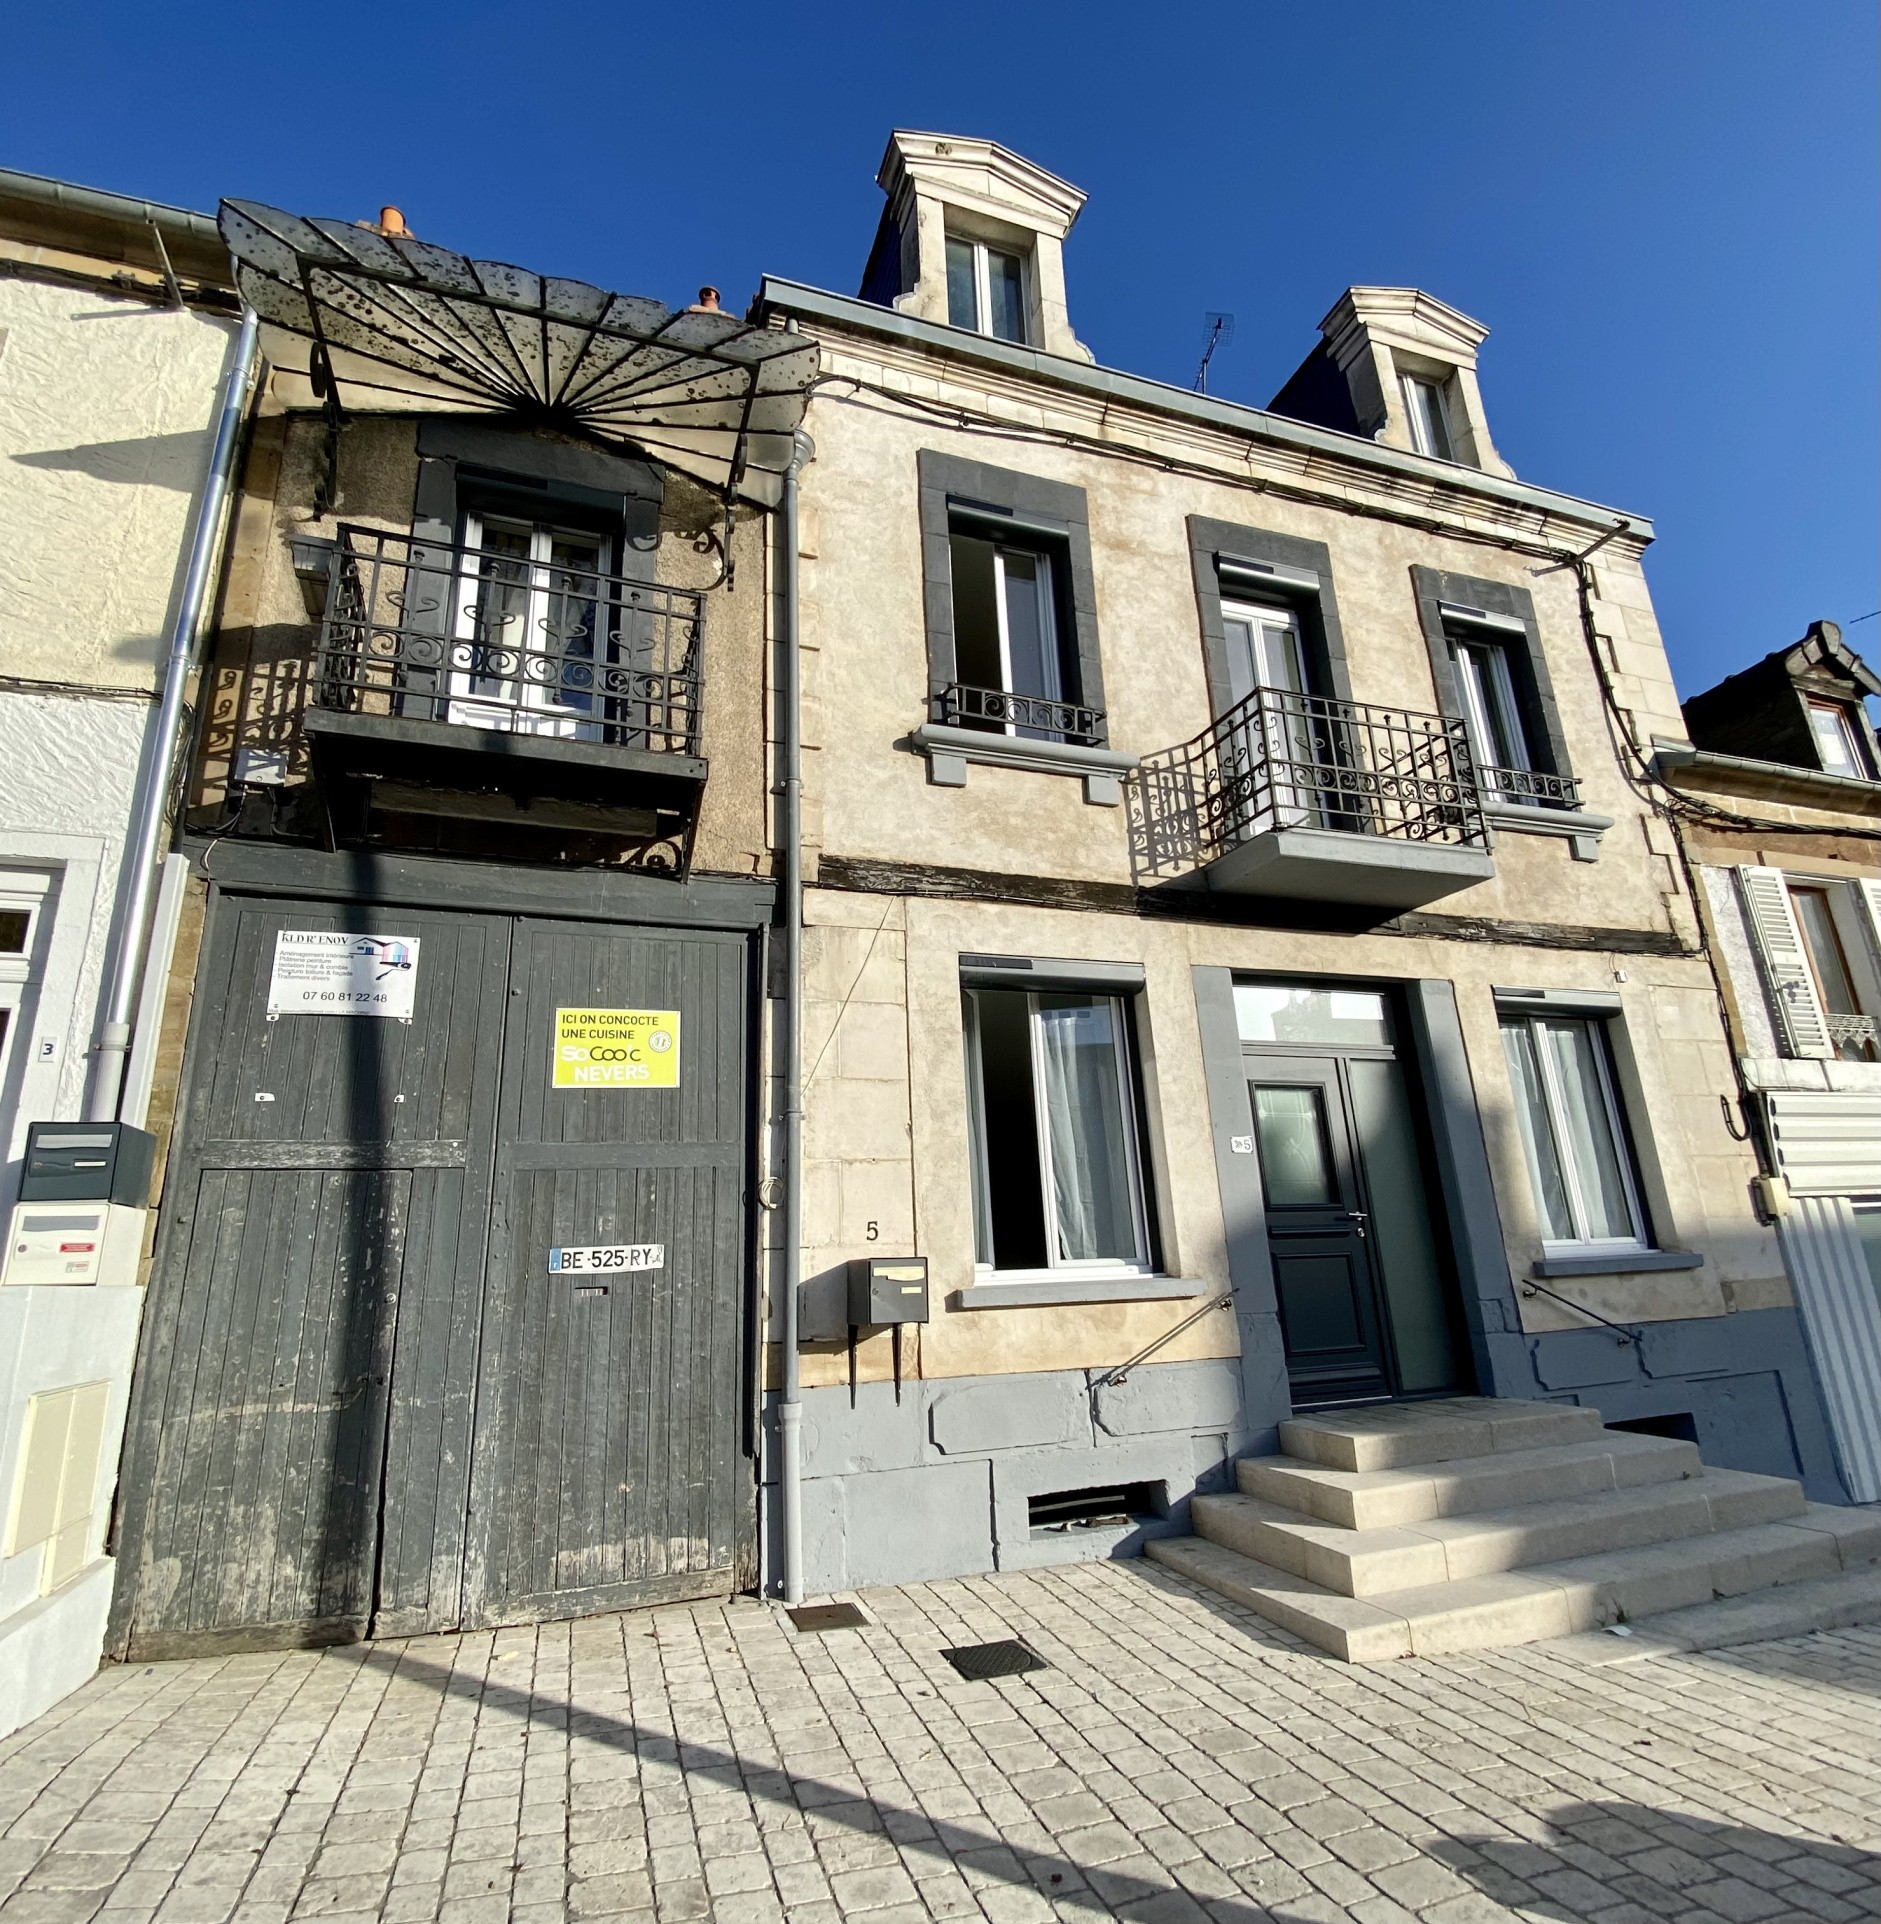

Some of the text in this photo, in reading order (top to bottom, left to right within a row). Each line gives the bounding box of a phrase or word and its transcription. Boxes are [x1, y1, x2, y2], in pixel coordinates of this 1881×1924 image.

[302, 991, 388, 1003] 07 60 81 22 48
[562, 1014, 659, 1026] ICI ON CONCOCTE
[561, 1029, 635, 1039] UNE CUISINE
[43, 1043, 54, 1055] 3
[574, 1064, 650, 1082] NEVERS
[1243, 1139, 1251, 1150] 5
[866, 1220, 879, 1241] 5
